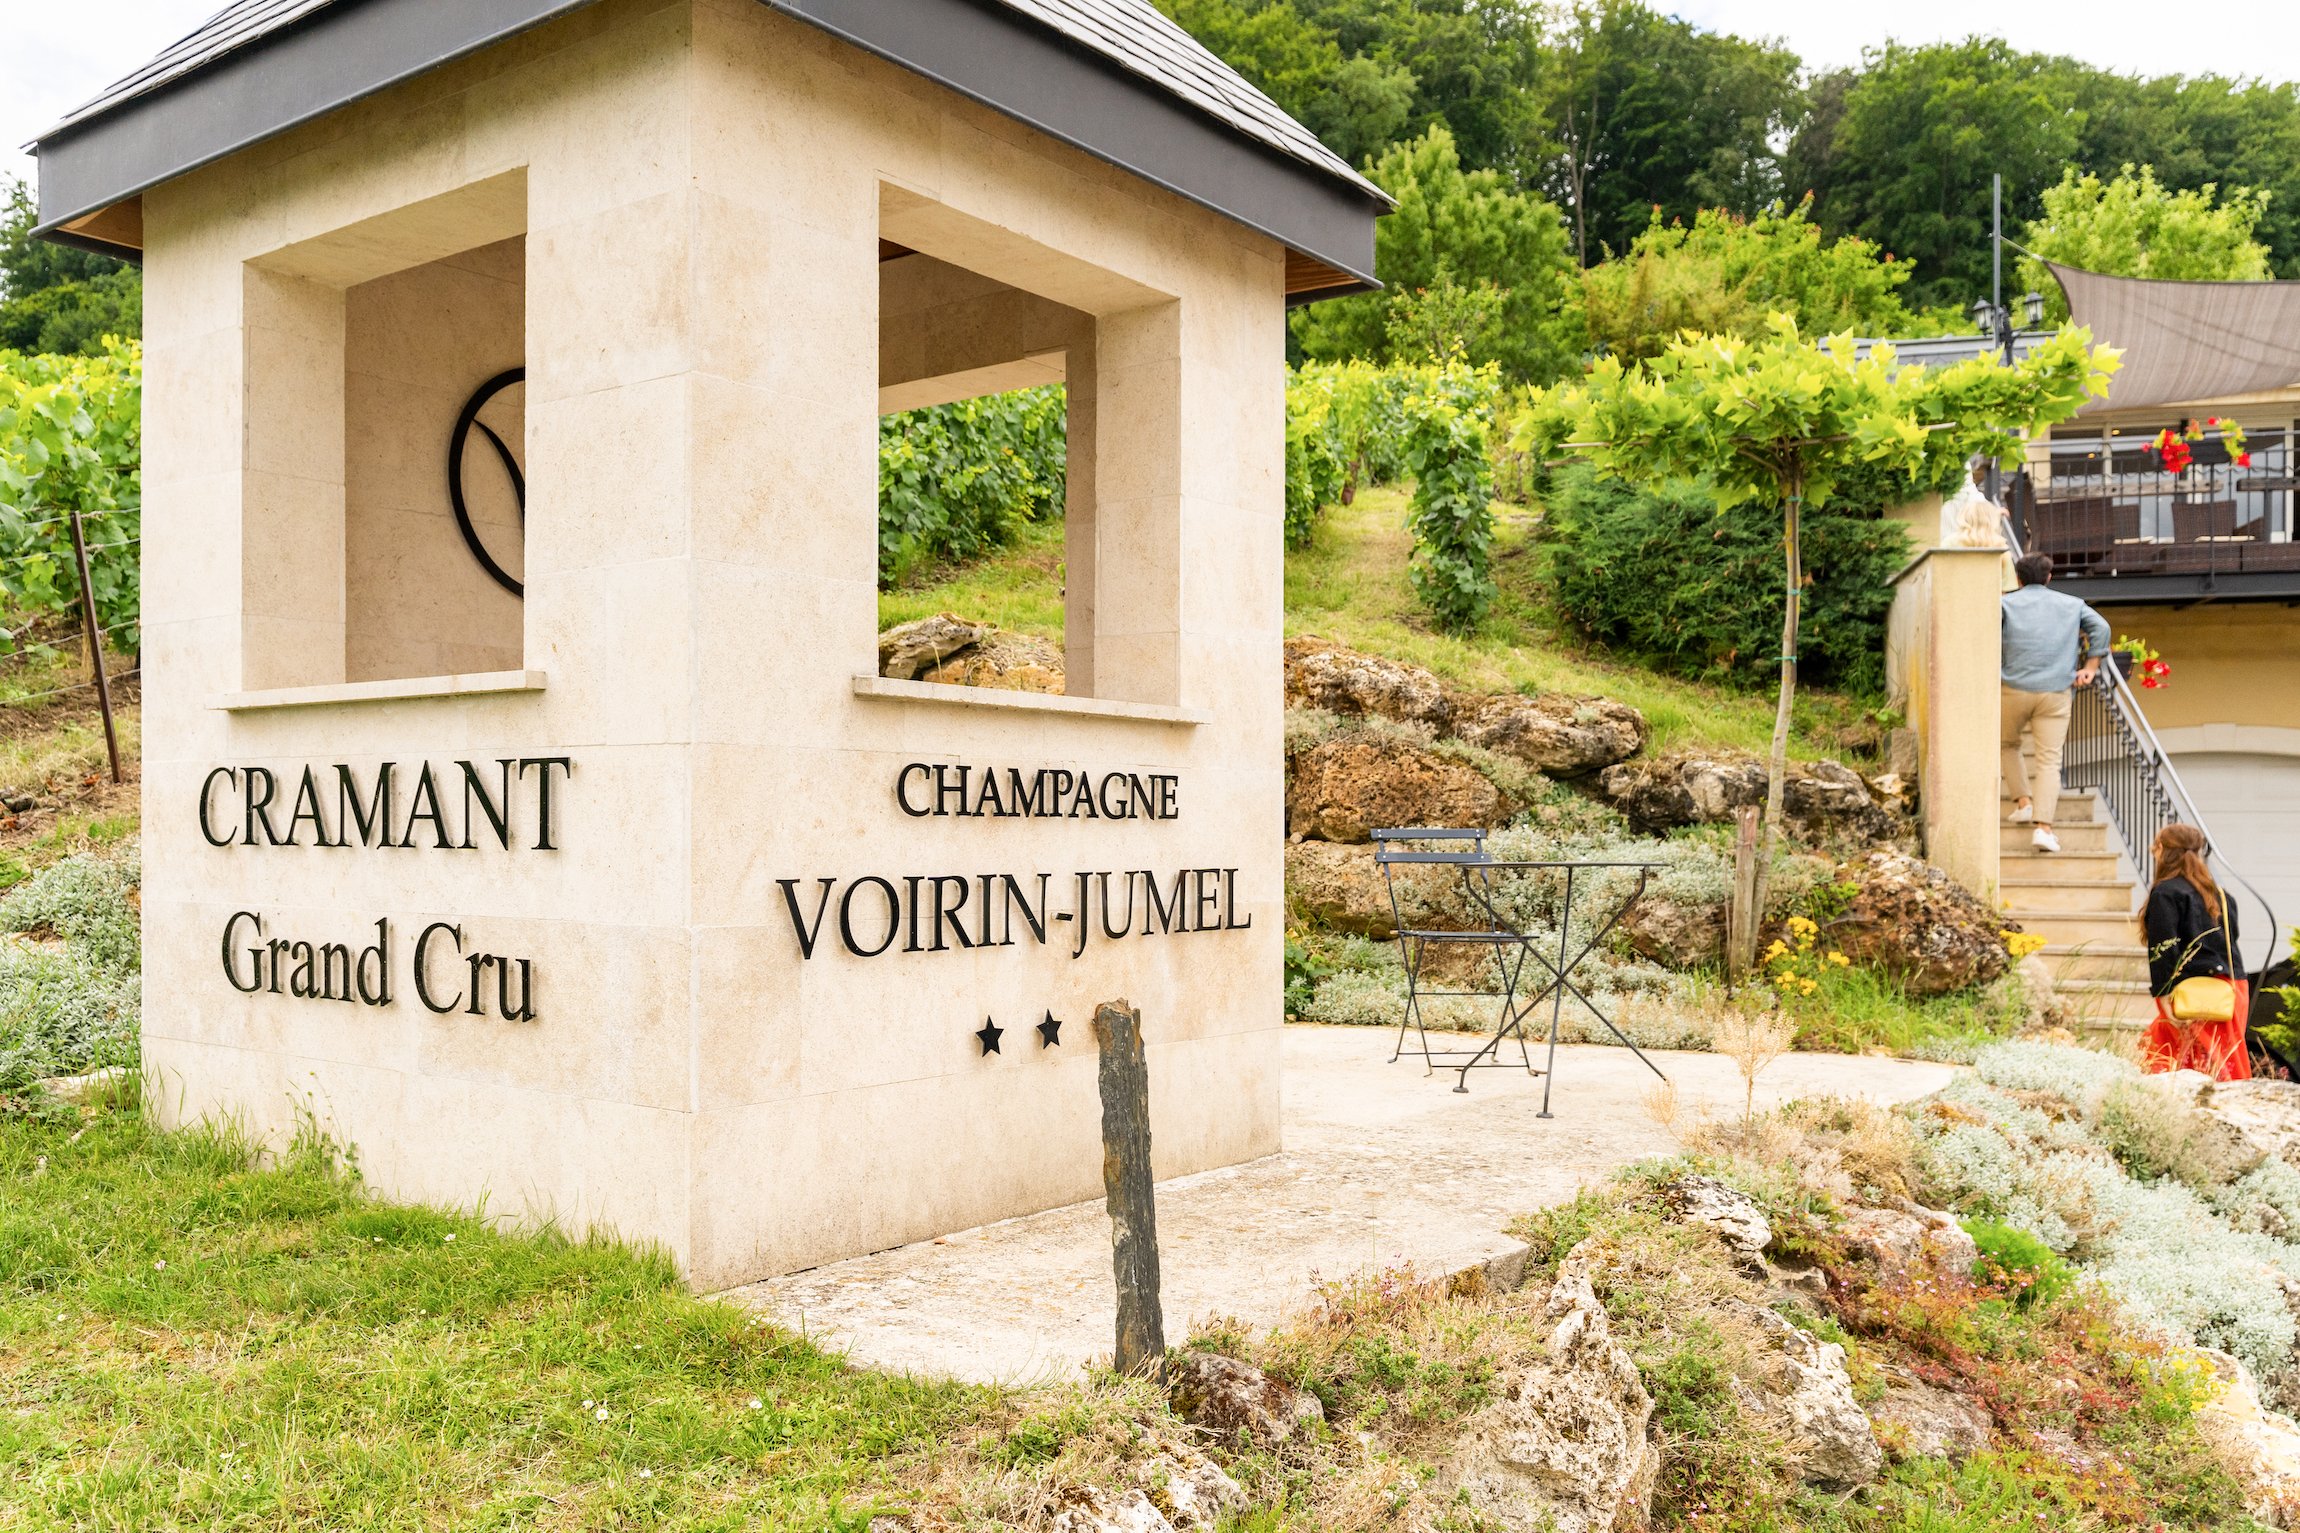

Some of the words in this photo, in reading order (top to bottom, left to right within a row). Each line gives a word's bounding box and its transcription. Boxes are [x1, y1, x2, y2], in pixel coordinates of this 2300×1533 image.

[199, 756, 571, 851] CRAMANT
[896, 762, 1179, 821] CHAMPAGNE
[775, 868, 1252, 960] VOIRIN-JUMEL
[221, 911, 393, 1007] Grand
[413, 922, 538, 1023] Cru
